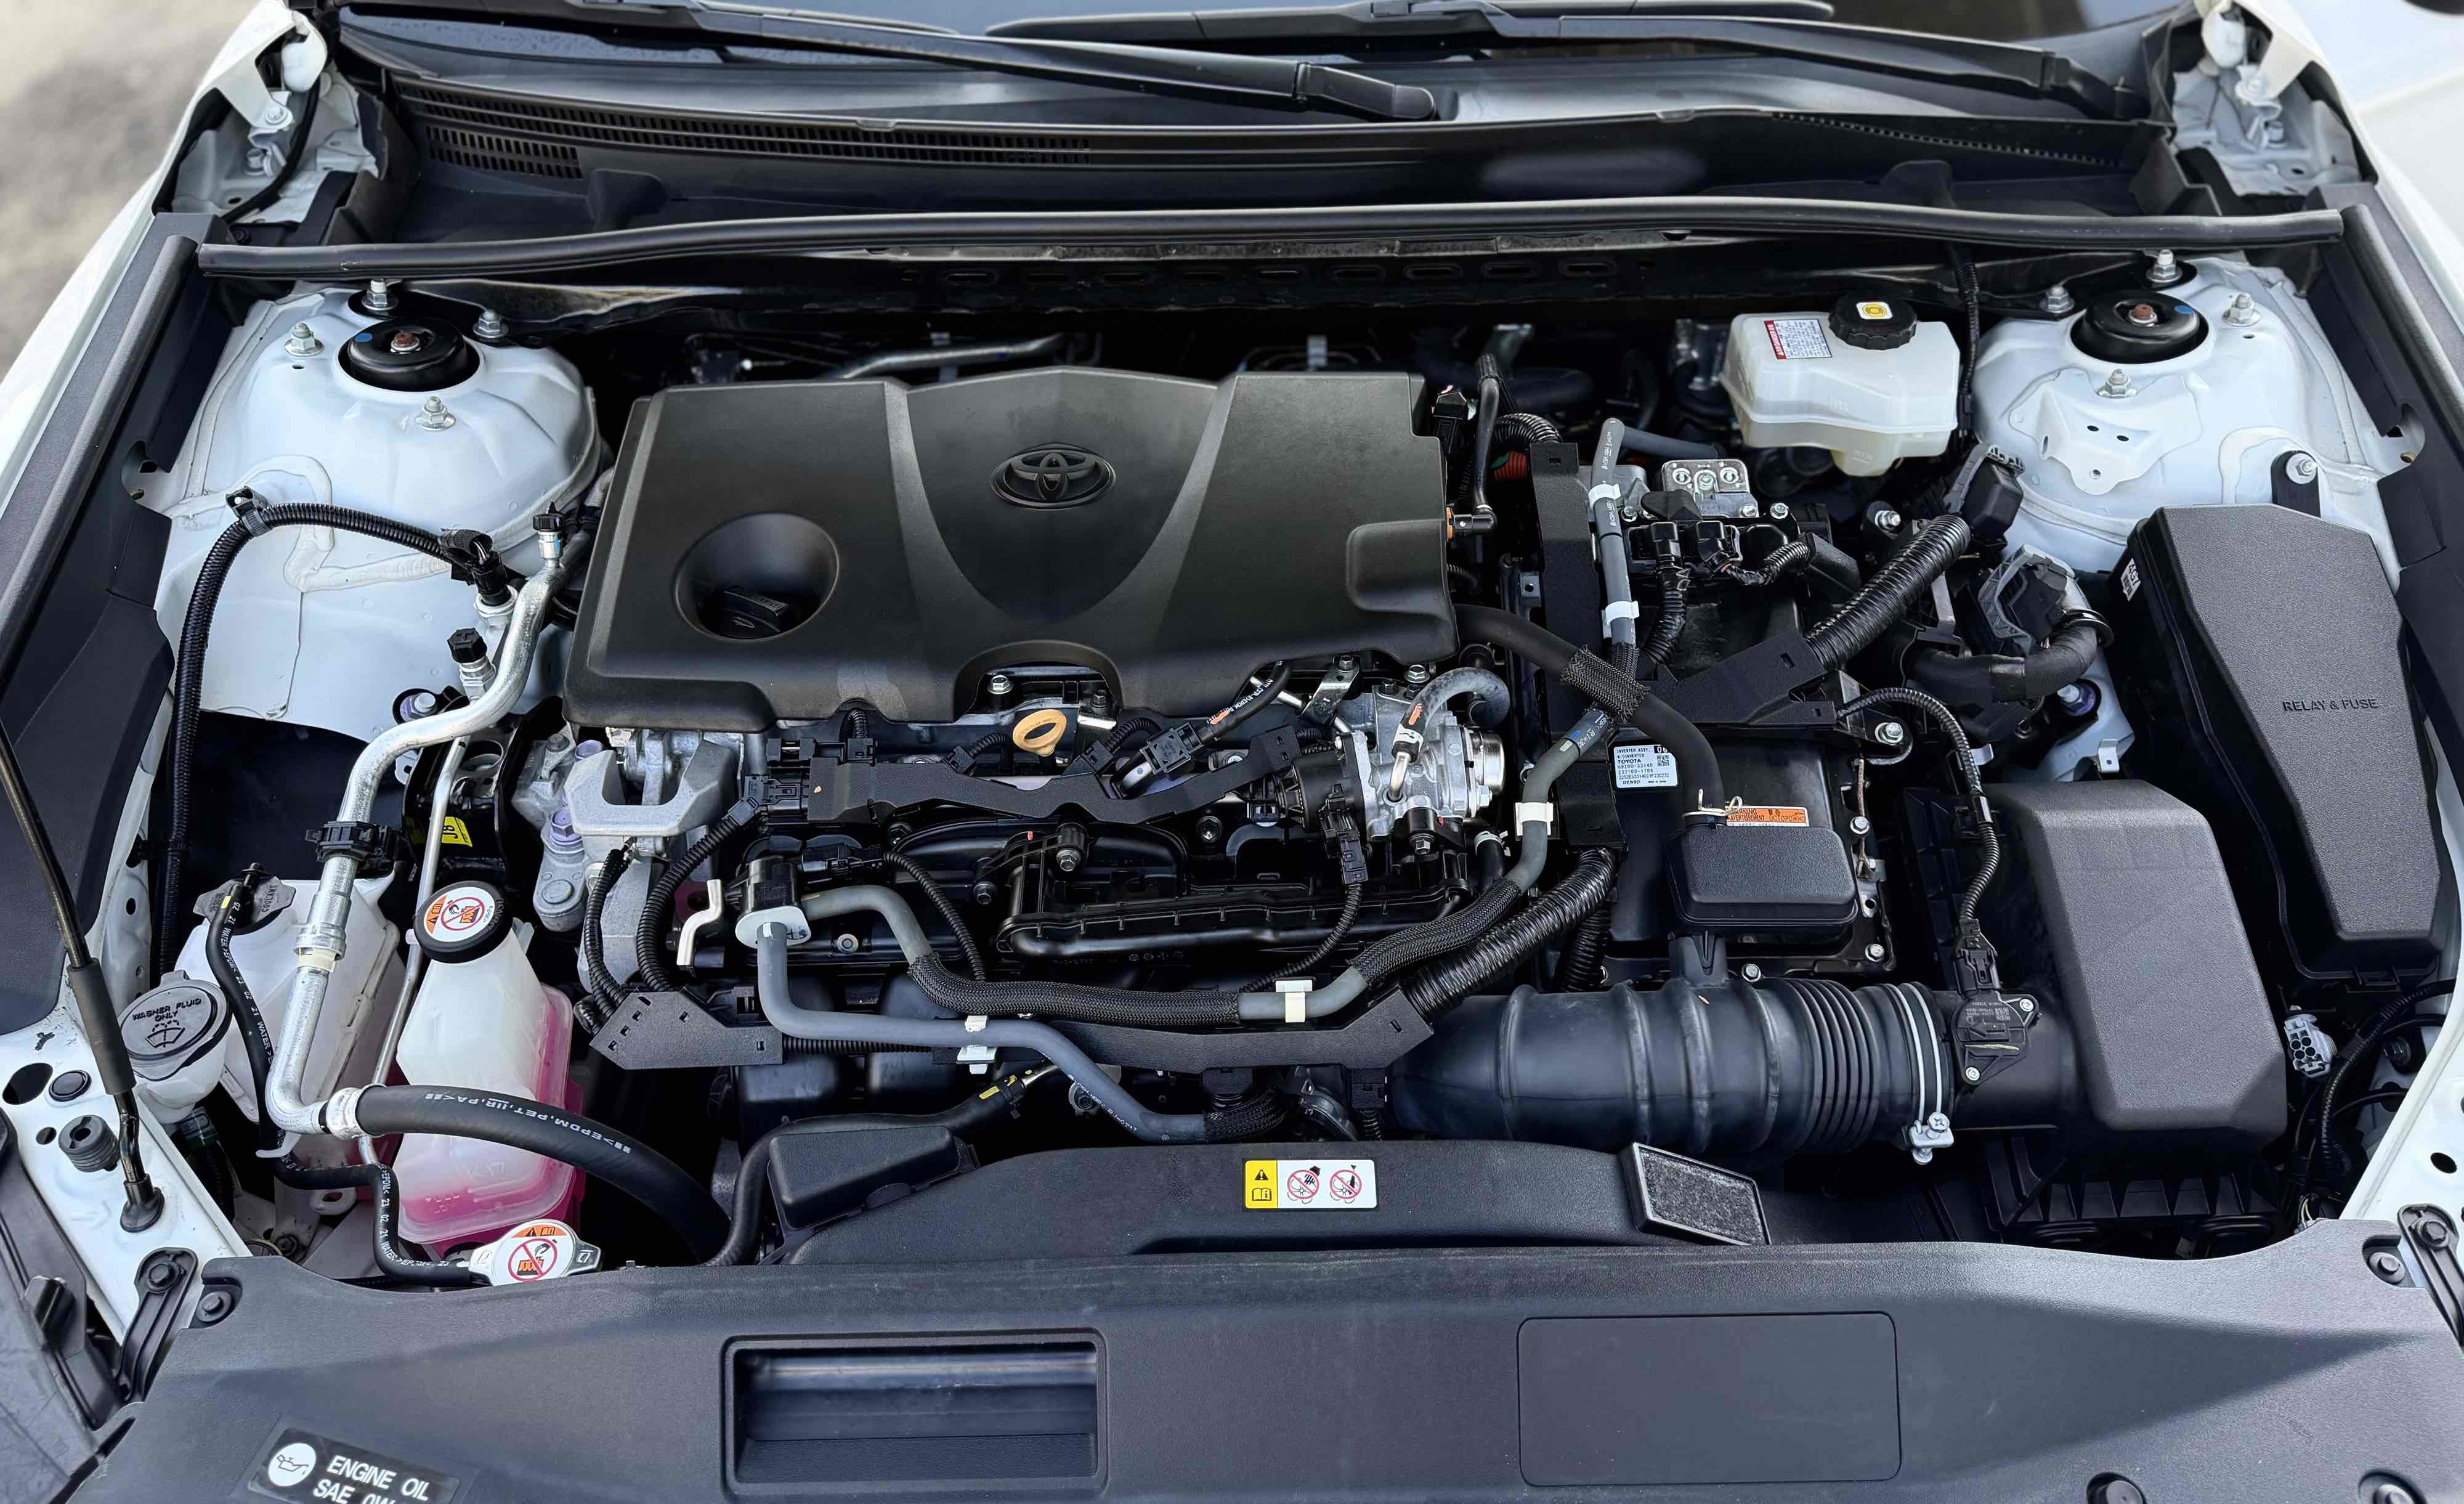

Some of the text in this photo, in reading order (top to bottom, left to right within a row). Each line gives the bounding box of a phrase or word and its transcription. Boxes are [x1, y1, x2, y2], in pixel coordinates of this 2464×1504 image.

[2282, 697, 2380, 712] RELAY & FUSE
[232, 901, 241, 911] 02
[261, 884, 278, 913] COOLANT
[221, 927, 232, 947] WATER
[132, 998, 202, 1021] WASHER FLUID
[154, 1010, 179, 1022] ONLY
[251, 1006, 260, 1016] 21
[257, 1021, 270, 1050] WATER
[381, 1198, 390, 1207] 23
[380, 1214, 389, 1223] 02
[380, 1241, 398, 1261] WATER
[326, 1455, 429, 1502] ENGINE OIL
[313, 1479, 355, 1504] SAE
